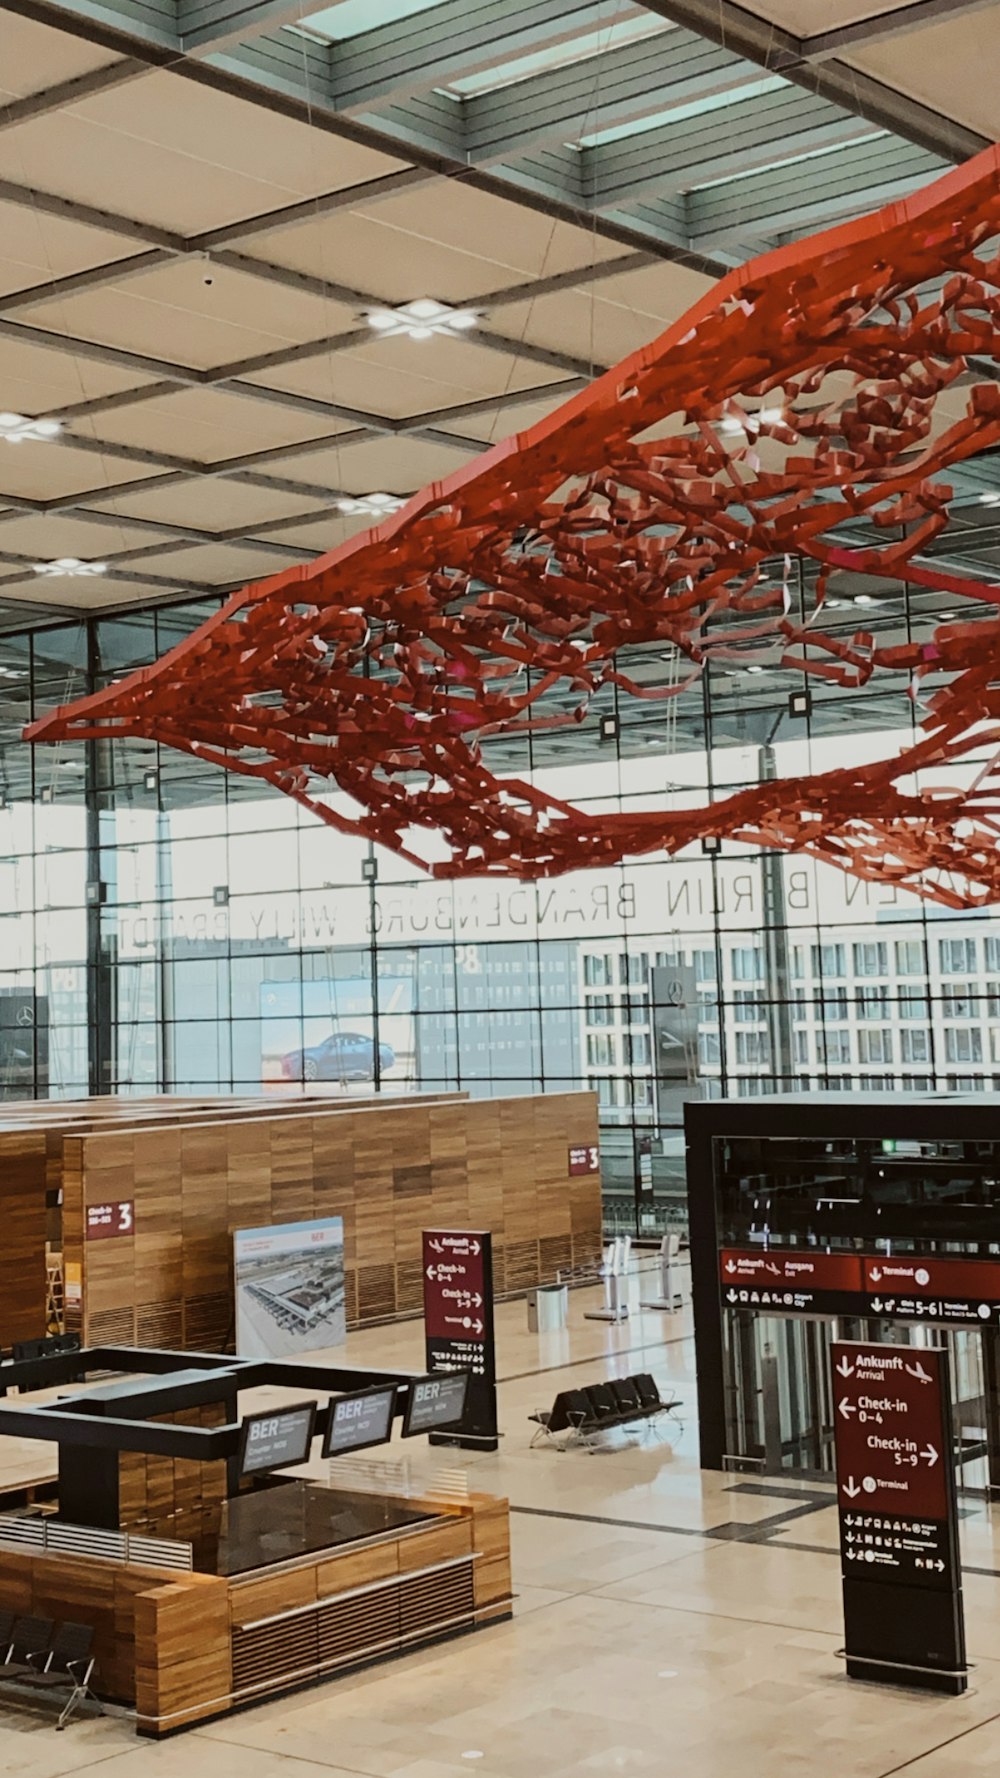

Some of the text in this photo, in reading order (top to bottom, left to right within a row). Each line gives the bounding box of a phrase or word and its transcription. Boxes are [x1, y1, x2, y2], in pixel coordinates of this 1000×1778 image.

[589, 1147, 599, 1169] 3
[118, 1203, 132, 1230] 3
[437, 1263, 466, 1274] Check-in
[784, 1261, 814, 1272] Ausgang
[882, 1266, 914, 1276] Terminal
[442, 1288, 471, 1299] Check-in
[916, 1301, 937, 1315] 5-6
[944, 1302, 969, 1311] Terminal
[855, 1354, 904, 1370] Ankunft
[856, 1369, 885, 1381] Arrival
[415, 1383, 440, 1402] BER
[337, 1401, 362, 1421] BER
[858, 1396, 908, 1412] Check-in
[858, 1410, 884, 1424] 0-4
[250, 1420, 279, 1441] BER
[867, 1435, 918, 1452] Check-in
[894, 1453, 918, 1467] 5-9
[877, 1479, 909, 1490] Terminal
